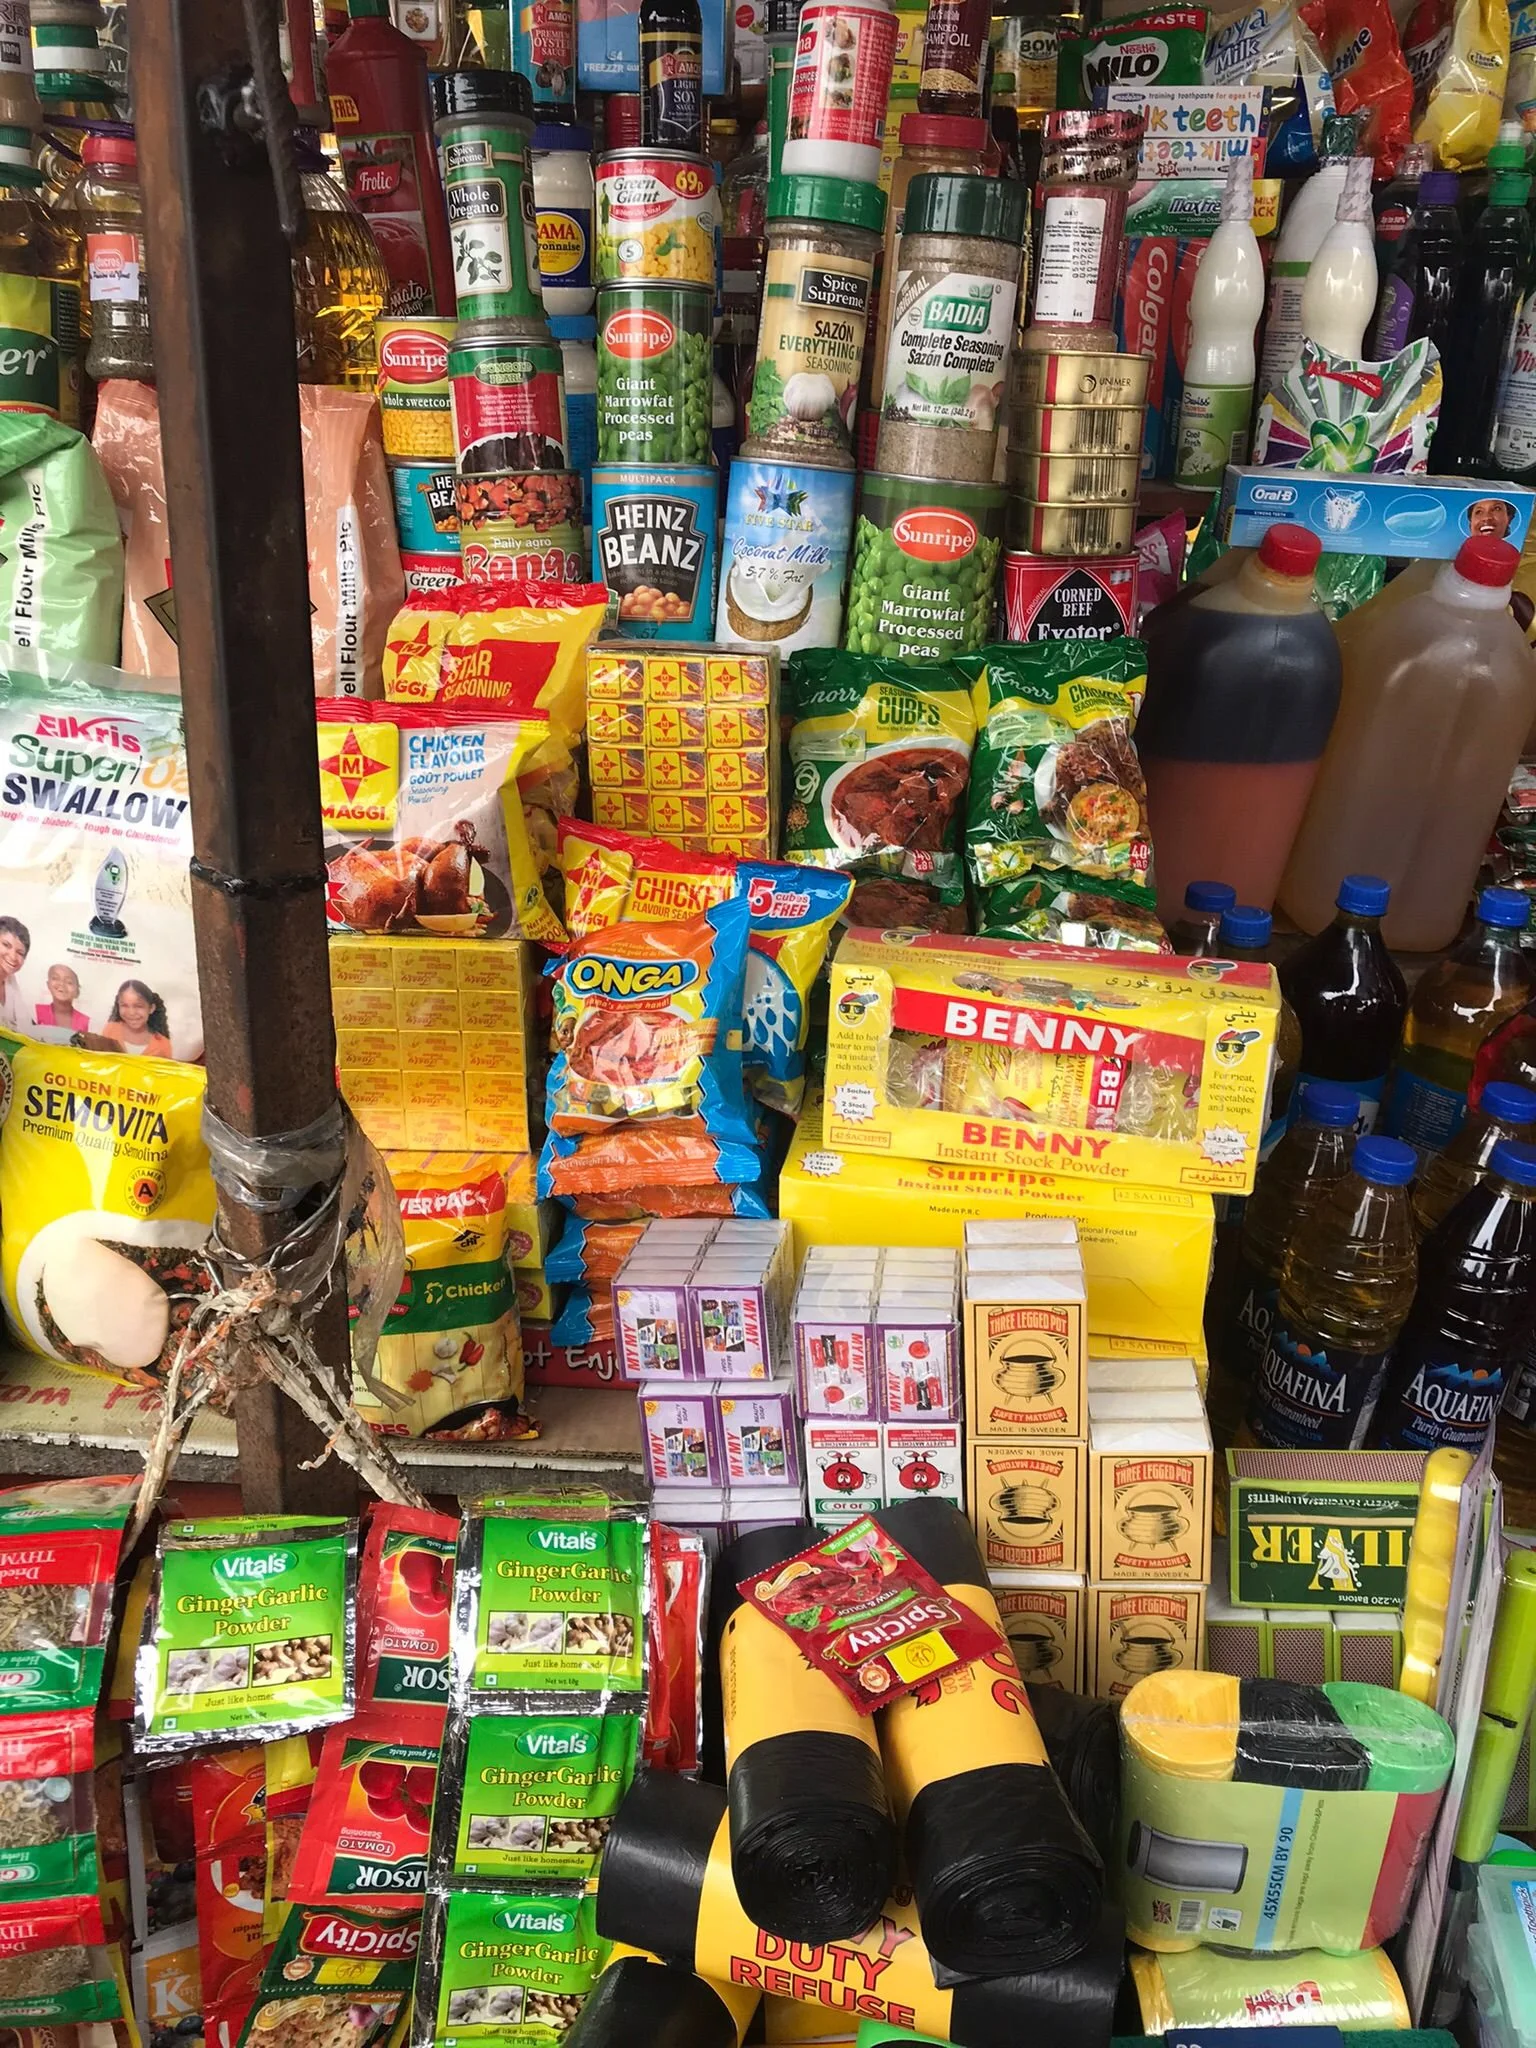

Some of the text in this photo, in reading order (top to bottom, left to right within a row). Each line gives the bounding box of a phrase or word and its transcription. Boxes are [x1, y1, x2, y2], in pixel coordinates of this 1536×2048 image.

[1143, 14, 1197, 27] TASTE
[1214, 36, 1260, 75] Milk
[1086, 53, 1160, 87] MILO
[1149, 92, 1175, 101] training
[1178, 92, 1214, 101] toothpaste
[1228, 93, 1246, 101] ages
[1248, 92, 1261, 100] 1-6
[335, 99, 357, 117] FREE
[1172, 103, 1256, 133] teeth
[359, 165, 392, 192] Frolic
[613, 177, 656, 191] Green
[675, 169, 704, 195] 69p
[451, 188, 490, 202] Whole
[617, 189, 660, 204] Giant
[450, 202, 499, 219] Oregano
[822, 276, 857, 293] Spice
[896, 276, 930, 321] ORIGINAL
[928, 300, 986, 327] BADIA
[606, 322, 669, 349] Sunripe
[815, 320, 855, 342] SAZÓN
[779, 334, 855, 361] EVERYTHING
[901, 330, 1004, 360] Complete Seasoning
[383, 348, 447, 371] Sunripe
[805, 356, 852, 374] SEASONING
[907, 349, 995, 373] Sazón Completa
[616, 377, 656, 390] Giant
[1100, 376, 1131, 388] UNIMER
[384, 395, 404, 408] whole
[604, 395, 674, 408] Marrowfat
[604, 412, 675, 425] Processed
[619, 430, 653, 444] peas
[620, 474, 677, 484] MULTIPACK
[1255, 488, 1293, 503] Oral-B
[615, 504, 688, 533] HEINZ
[493, 537, 551, 549] Pally agro
[895, 523, 974, 551] Sunripe
[603, 533, 704, 572] BEANZ
[732, 542, 830, 566] Coconut Milk
[16, 522, 46, 619] Flour Mills
[409, 572, 458, 588] Green
[340, 520, 358, 665] Flour Mills Plc
[902, 584, 951, 603] Giant
[1054, 588, 1102, 603] CORNED
[881, 600, 966, 622] Marrowfat
[1062, 602, 1092, 617] BEEF
[878, 619, 963, 641] Processed
[898, 643, 940, 657] peas
[449, 650, 492, 681] STAR
[877, 697, 941, 727] CUBES
[409, 732, 485, 754] CHICKEN
[8, 733, 138, 785] Super
[410, 749, 486, 770] FLAVOUR
[409, 769, 483, 786] GOÛT POULET
[2, 772, 188, 830] SWALLOW
[321, 804, 386, 821] MAGGI
[749, 878, 810, 917] 5 cubes
[632, 901, 670, 917] FLAVOUR
[771, 902, 810, 919] FREE
[571, 958, 683, 995] ONGA
[837, 1032, 864, 1041] Add to
[945, 1002, 1146, 1057] BENNY
[835, 1063, 874, 1072] rich stock
[44, 1072, 112, 1096] GOLDEN
[1209, 1094, 1255, 1105] vegetables
[24, 1085, 168, 1144] SEMOVITA
[1226, 1105, 1253, 1116] soups.
[22, 1118, 73, 1142] Premium
[123, 1141, 168, 1162] Semolina
[963, 1122, 1111, 1159] BENNY
[936, 1143, 1130, 1178] Instant Stock Powder
[927, 1166, 1056, 1188] Sunripe
[137, 1182, 152, 1199] A
[897, 1178, 1085, 1203] Instant Stock Powder
[929, 1205, 950, 1214] Made
[990, 1311, 1067, 1334] THREE LEGGED POT
[992, 1408, 1064, 1422] SAFETY MATCHES
[990, 1426, 1066, 1434] MADE IN SWEDEN
[1115, 1462, 1192, 1486] THREE LEGGED POT
[1117, 1554, 1187, 1567] SAFETY MATCHES
[497, 1560, 632, 1585] GingerGarlic
[1154, 1571, 1190, 1579] SWEDEN
[177, 1583, 328, 1615] GingerGarlic
[529, 1587, 602, 1604] Powder
[1112, 1597, 1186, 1618] THREE LEGGED POT
[214, 1615, 291, 1637] Powder
[384, 1624, 426, 1637] Seasoning
[848, 1604, 947, 1654] SpiCity
[384, 1638, 436, 1653] TOMATO
[522, 1658, 559, 1670] Just like
[205, 1694, 245, 1708] Just like
[481, 1765, 622, 1788] GingerGarlic
[513, 1791, 587, 1811] Powder
[341, 1826, 383, 1840] Seasoning
[339, 1838, 393, 1856] TOMATO
[502, 1854, 585, 1866] Just like homemade
[1264, 1826, 1294, 1921] 45X55CM BY 90
[755, 1926, 891, 1992] DUTY
[491, 1962, 563, 1987] Powder
[729, 1955, 917, 2031] REFUSE
